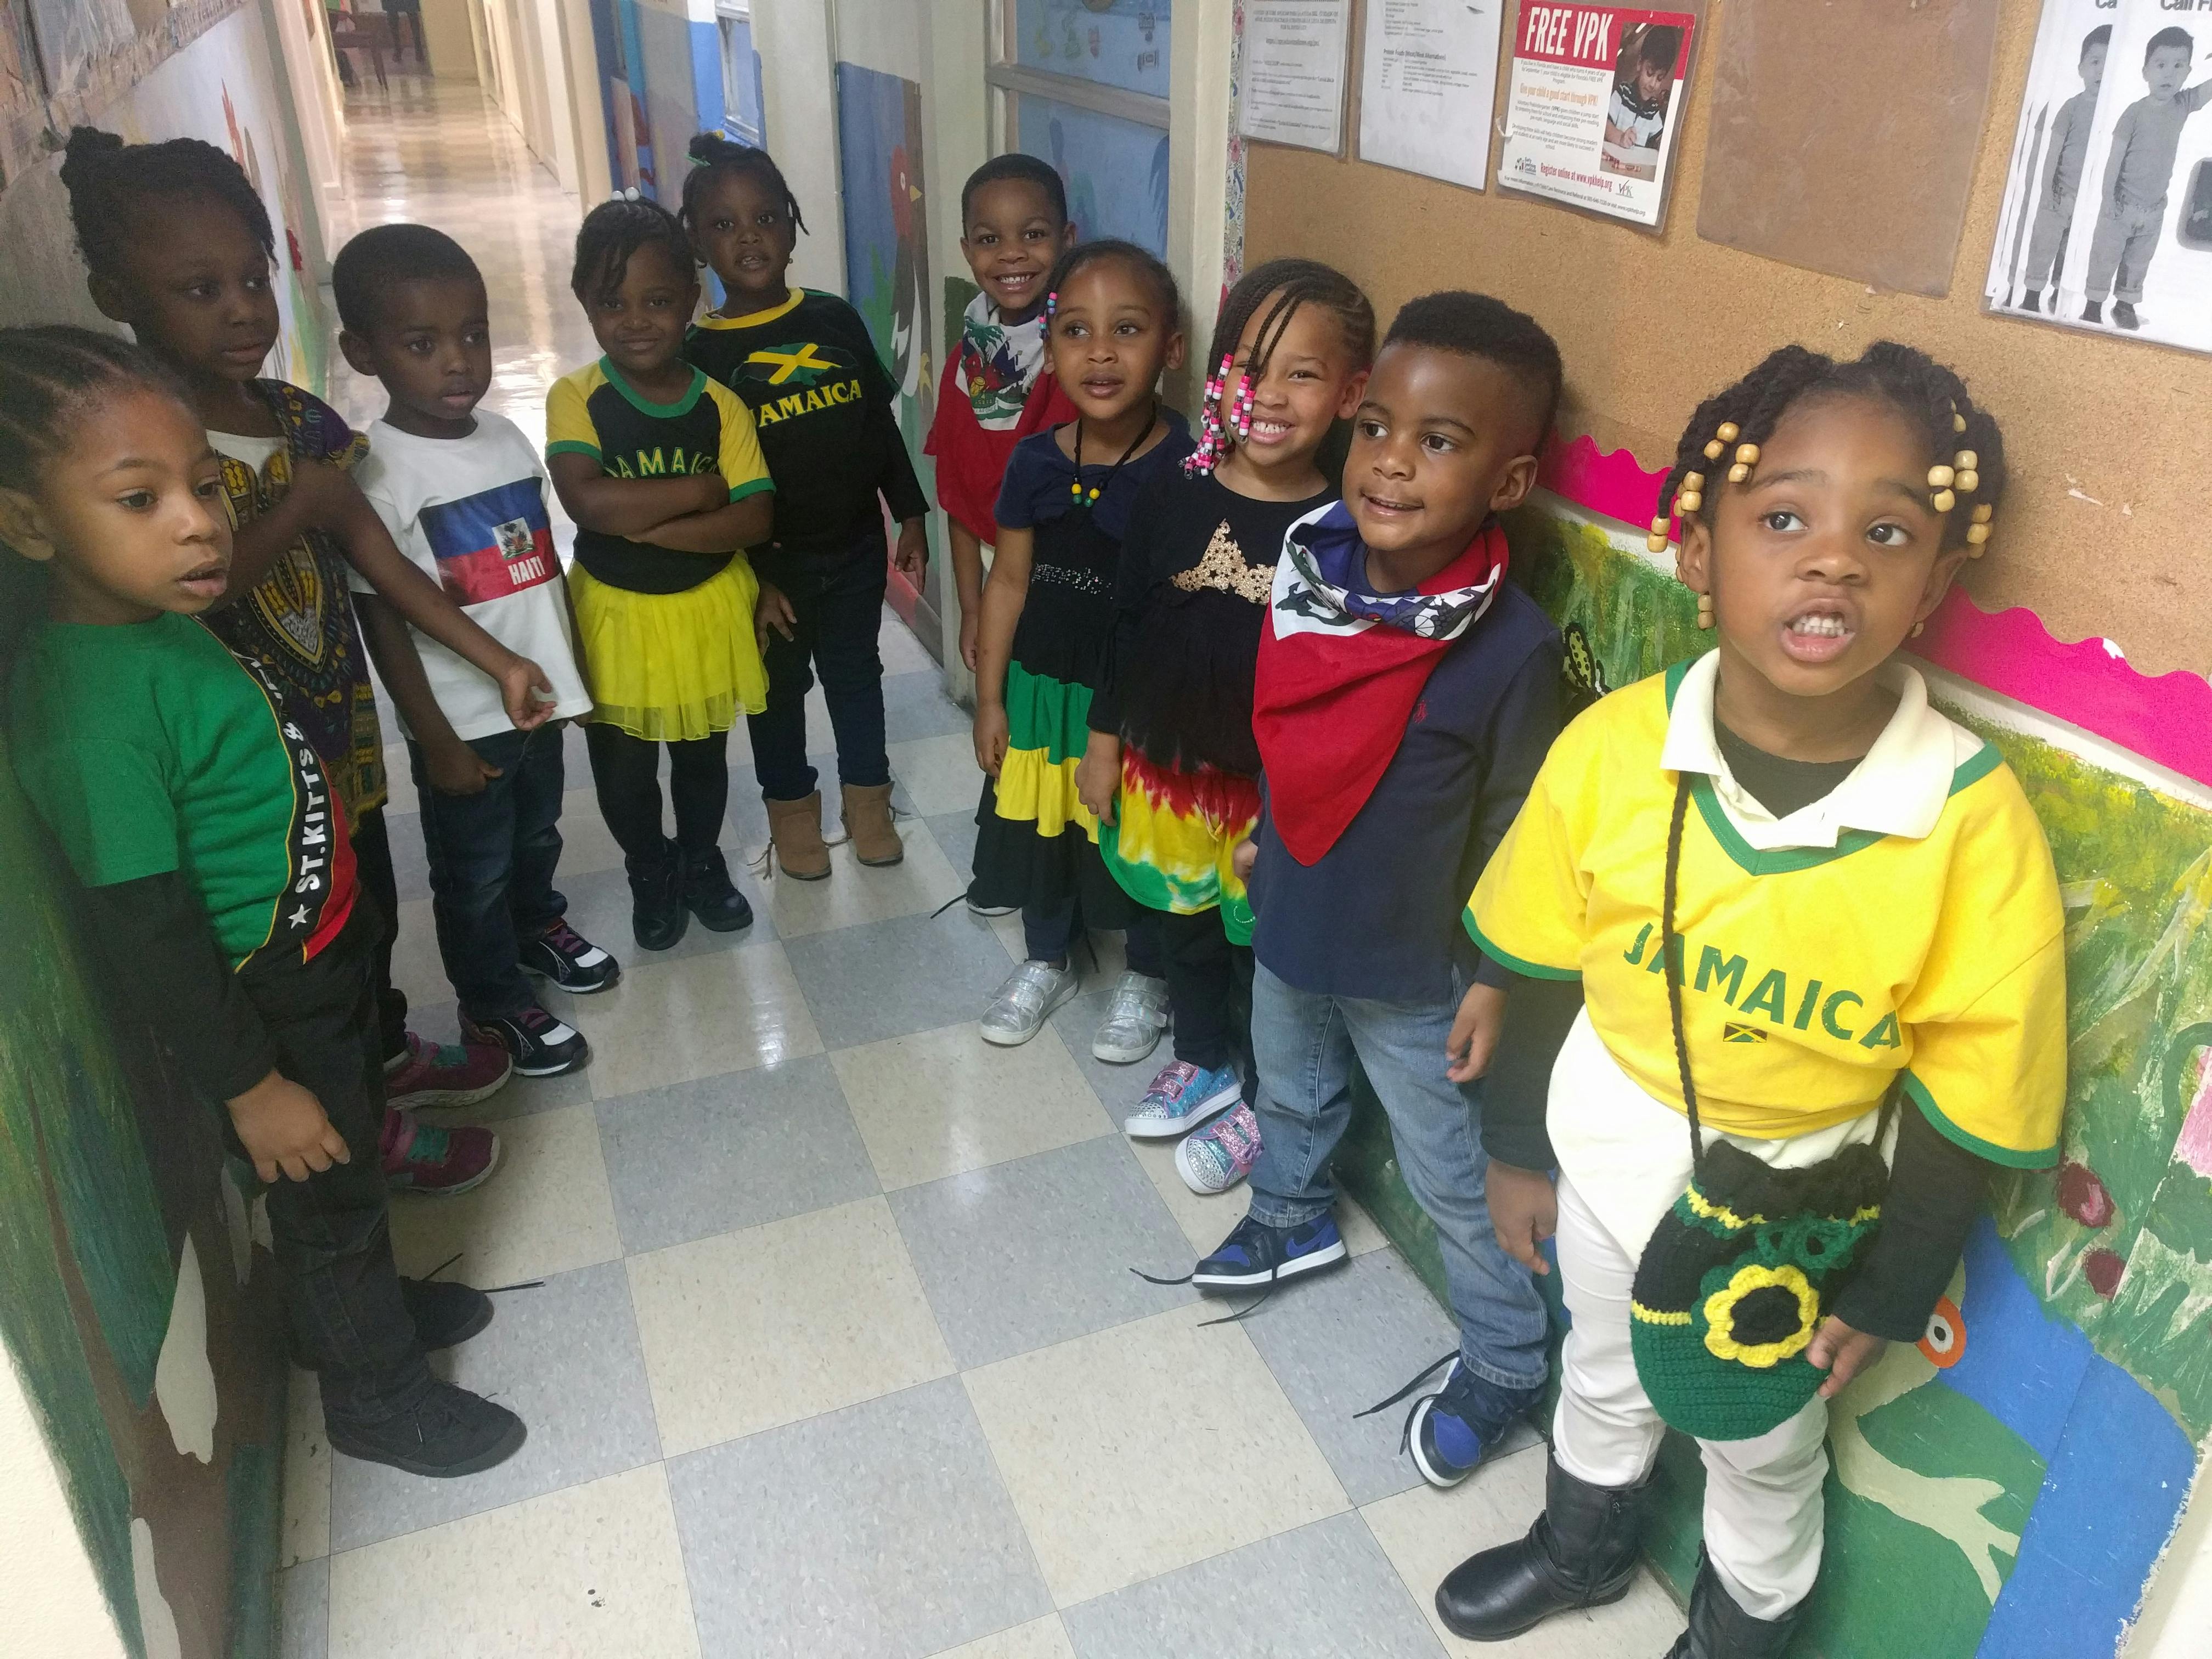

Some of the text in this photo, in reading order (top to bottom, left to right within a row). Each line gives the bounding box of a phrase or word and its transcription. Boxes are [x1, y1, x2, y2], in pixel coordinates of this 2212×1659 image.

[2197, 0, 2212, 11] F
[1525, 7, 1613, 61] FREE VPK
[1540, 162, 1613, 192] Register online at www.vpkhelp.org
[507, 556, 545, 585] HAITI
[1624, 922, 1902, 1051] JAMAICA
